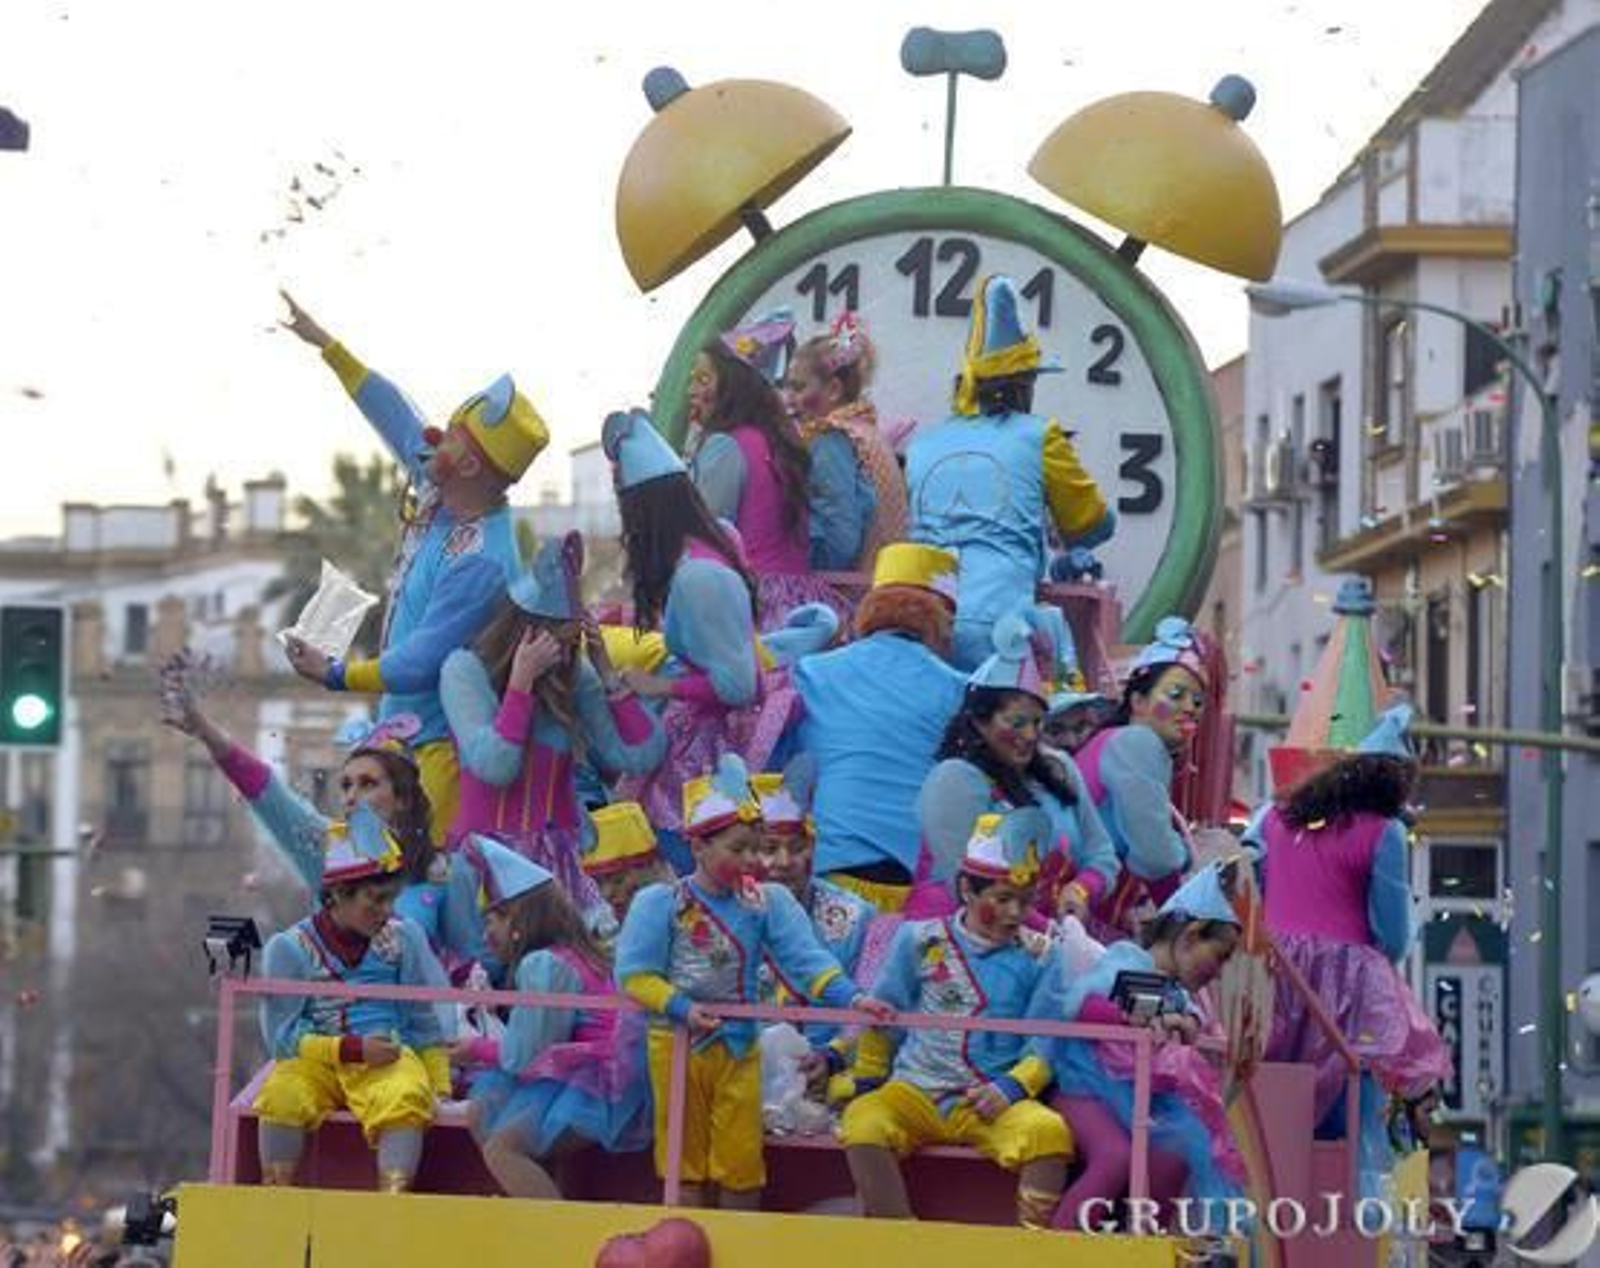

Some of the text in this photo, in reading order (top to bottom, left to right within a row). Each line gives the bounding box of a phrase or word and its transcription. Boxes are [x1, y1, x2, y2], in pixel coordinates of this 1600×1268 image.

[796, 263, 860, 322] 11
[896, 236, 981, 317] 12
[1020, 267, 1055, 328] 1
[1087, 324, 1125, 386] 2
[1117, 432, 1164, 516] 3
